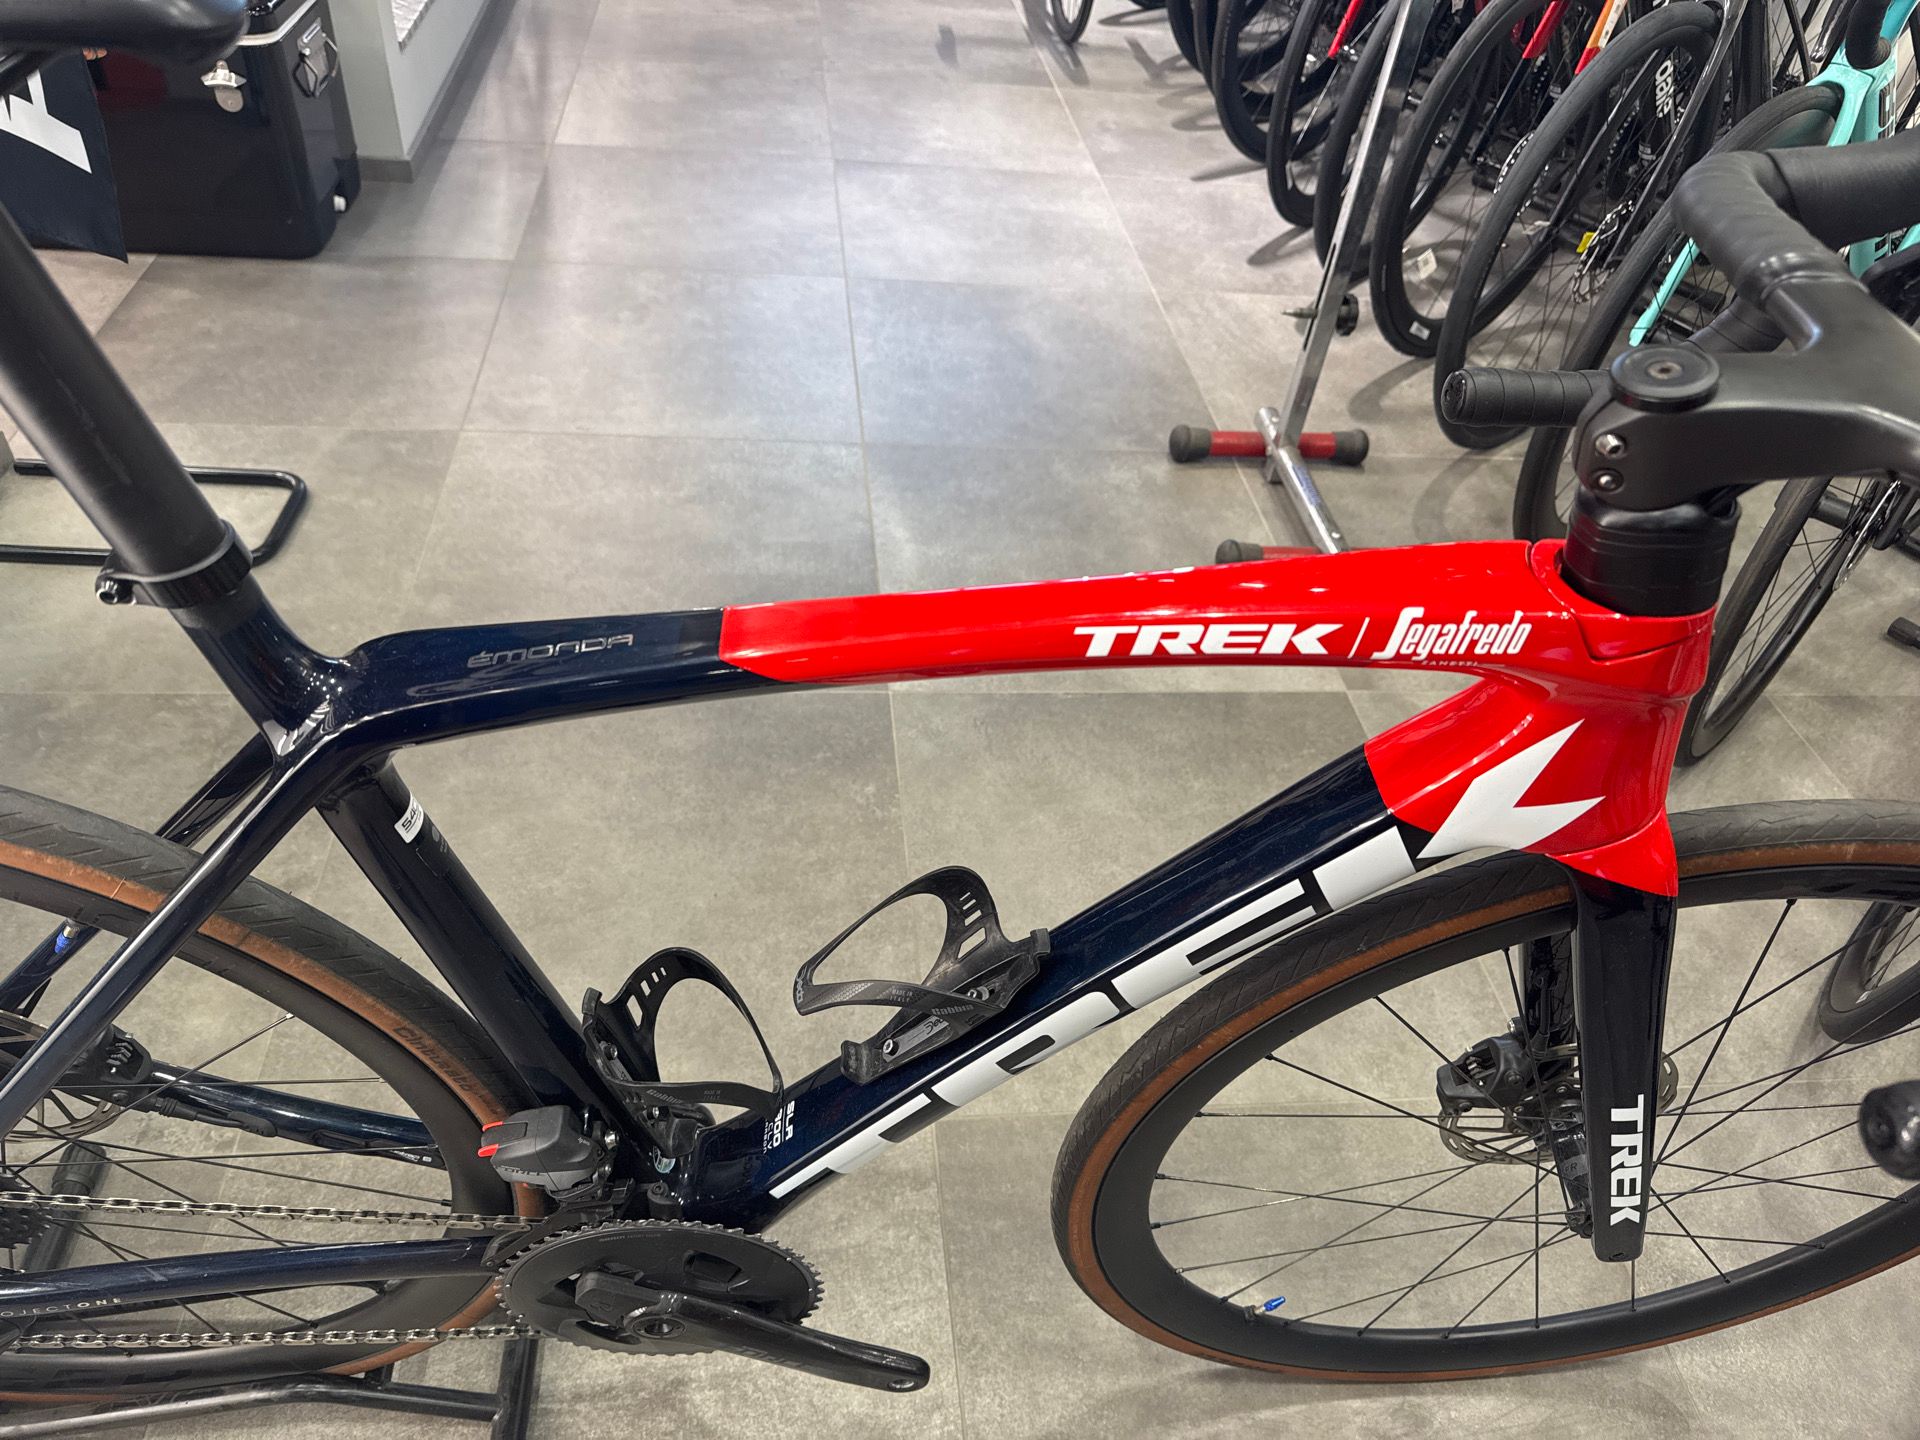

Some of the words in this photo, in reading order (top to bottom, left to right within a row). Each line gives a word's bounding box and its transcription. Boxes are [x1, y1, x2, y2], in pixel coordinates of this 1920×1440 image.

[1073, 623, 1344, 657] TREK
[1370, 606, 1533, 662] Segafredo
[785, 1100, 796, 1141] SLR
[1610, 1093, 1645, 1226] TREK
